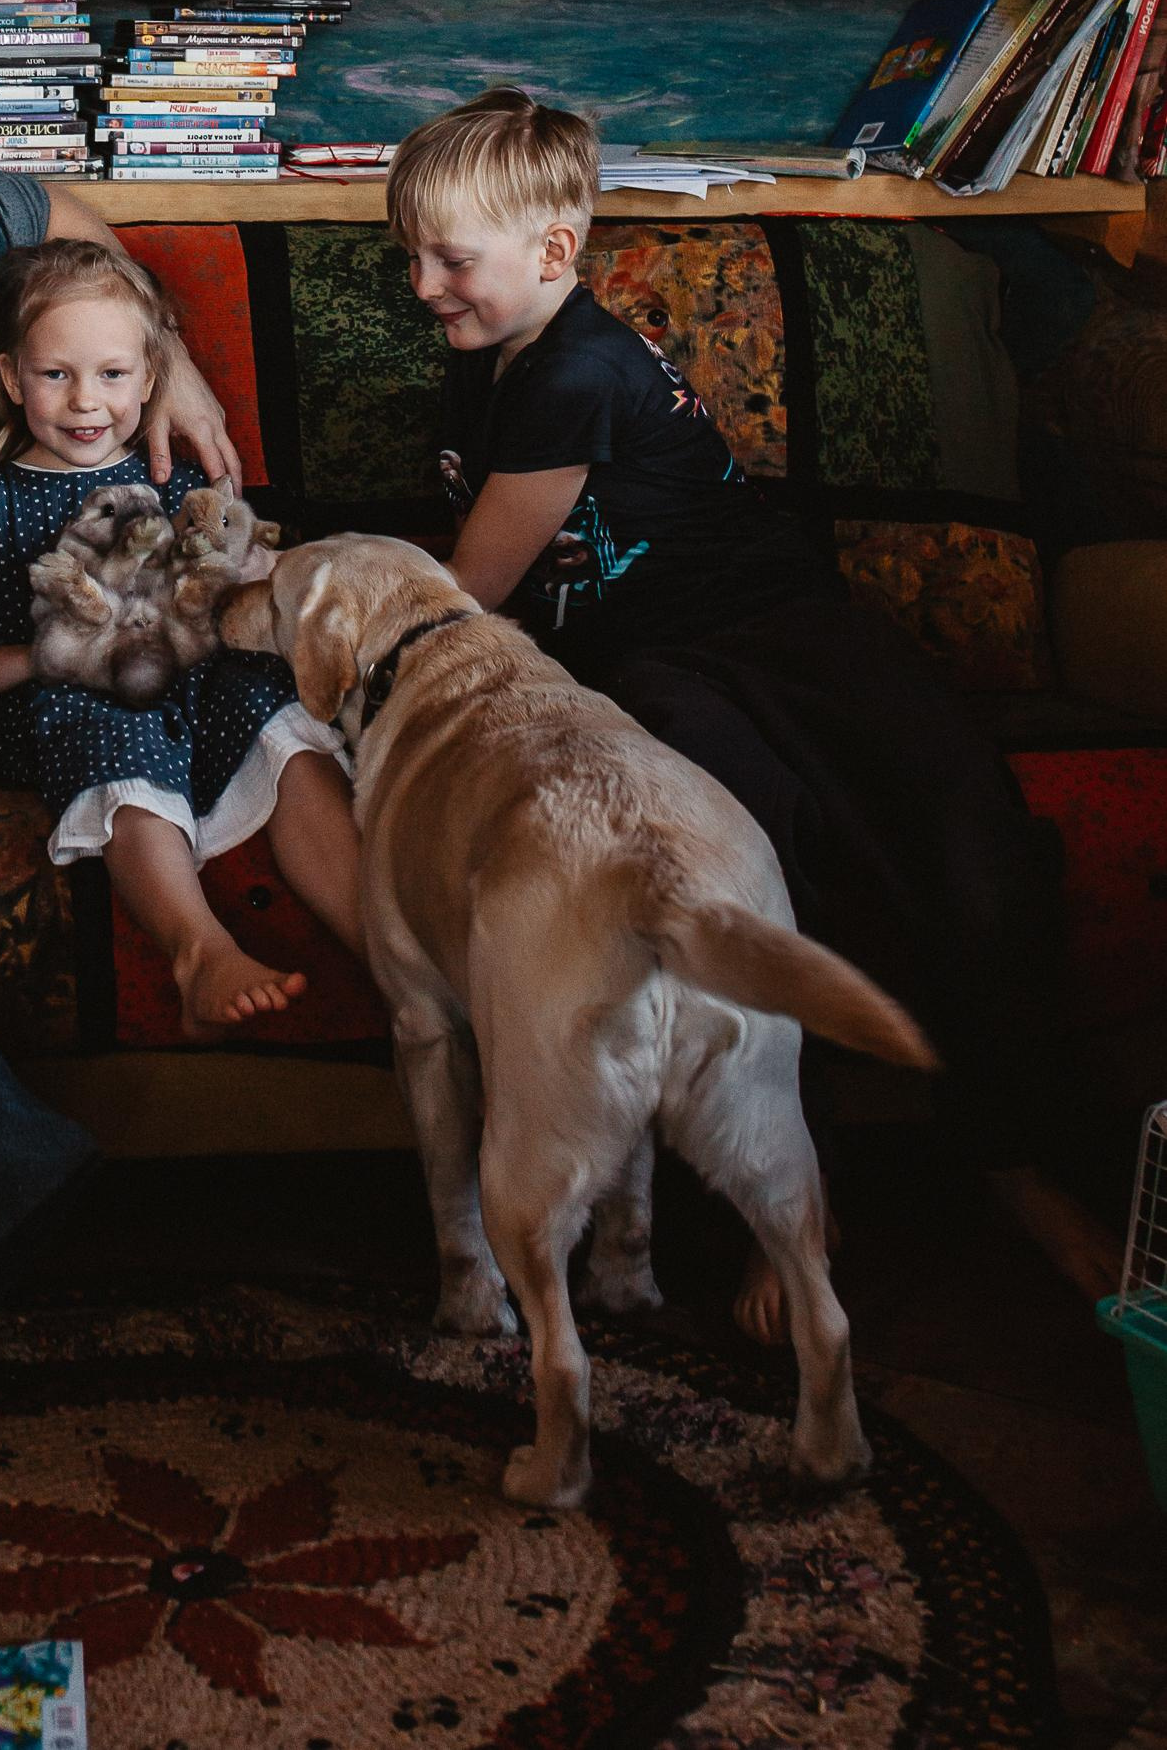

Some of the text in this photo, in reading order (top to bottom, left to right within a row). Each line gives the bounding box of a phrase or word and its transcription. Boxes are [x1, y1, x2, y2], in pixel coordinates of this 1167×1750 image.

[185, 34, 229, 45] Мужчина
[239, 35, 283, 46] Женщина
[6, 136, 28, 144] JONES
